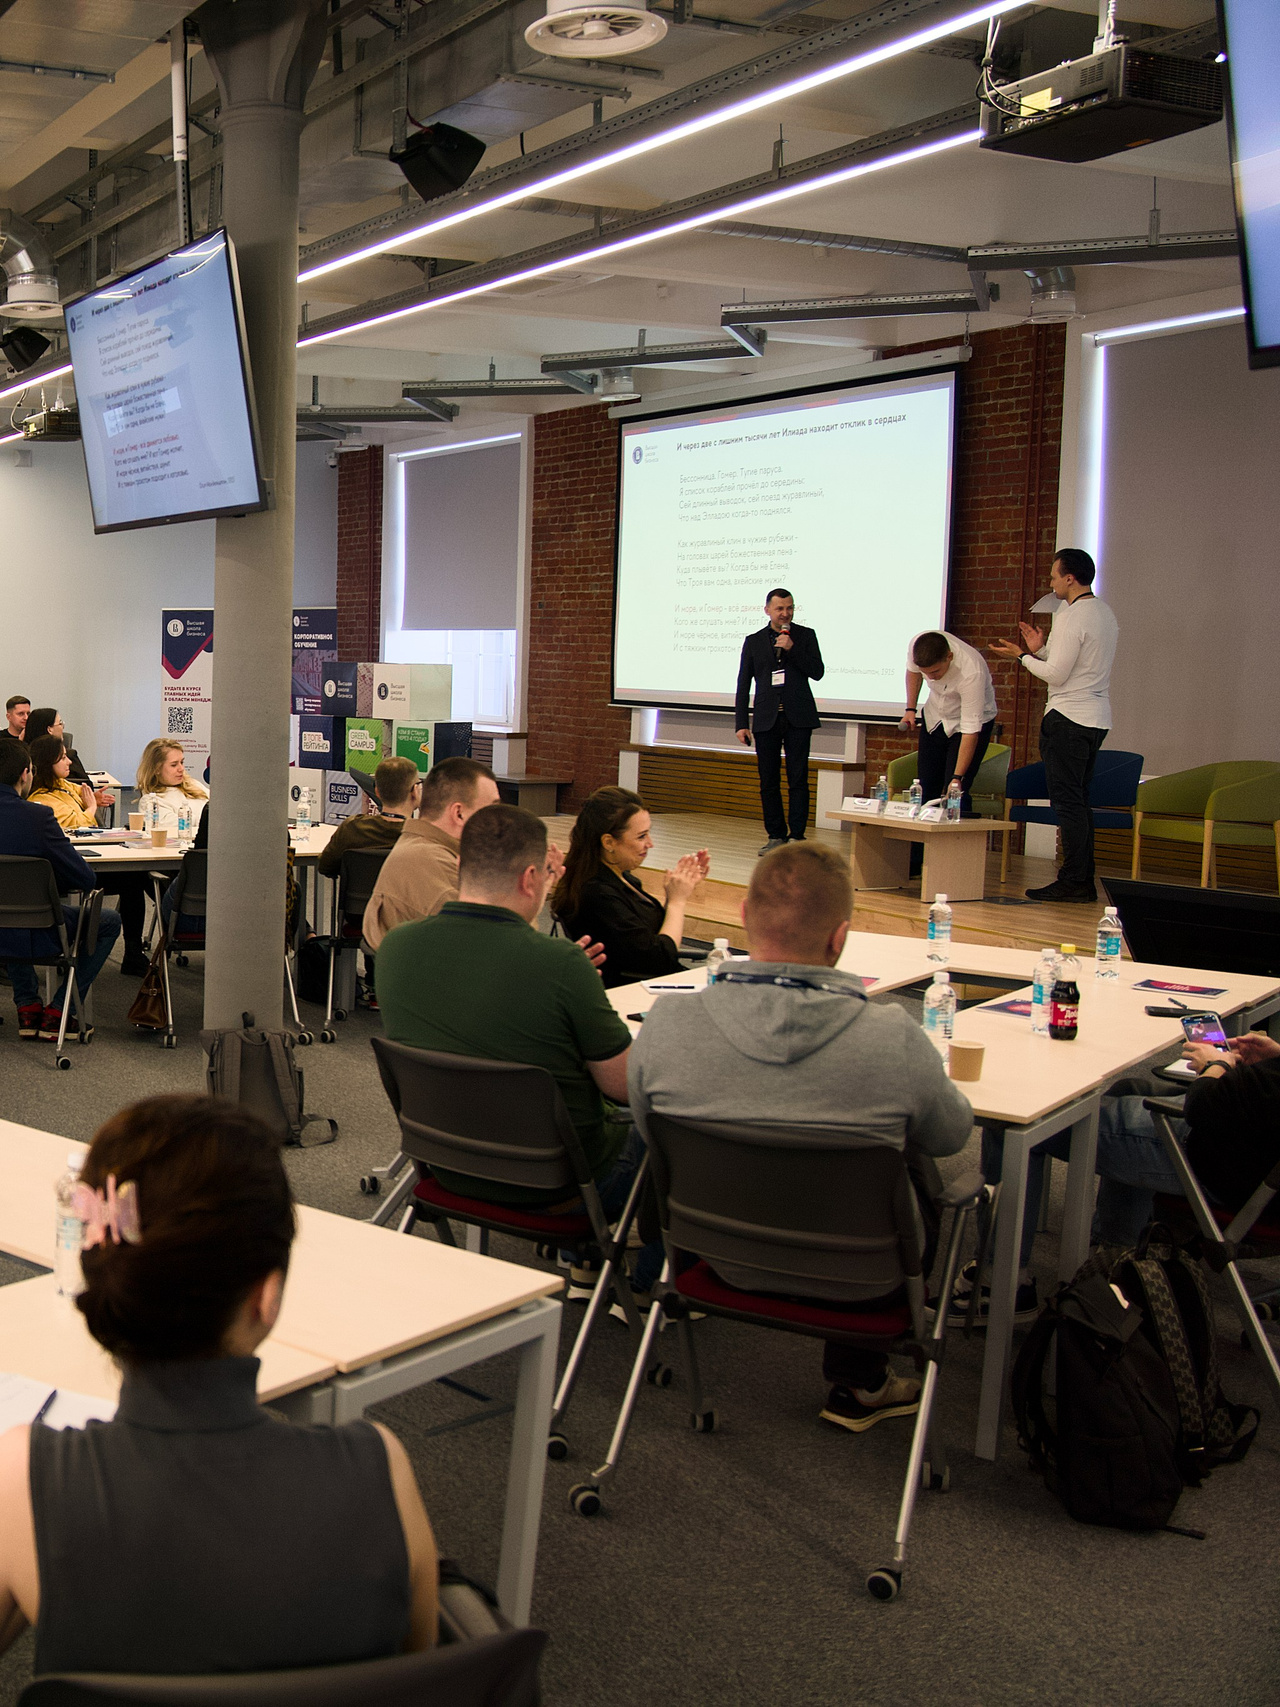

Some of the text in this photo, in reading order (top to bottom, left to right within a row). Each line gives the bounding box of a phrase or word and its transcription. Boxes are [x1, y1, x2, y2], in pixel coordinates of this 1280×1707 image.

[676, 443, 682, 451] И
[683, 443, 700, 452] через
[701, 441, 712, 449] две
[718, 438, 743, 446] лишним
[745, 434, 767, 442] тысячи
[782, 428, 808, 437] Илиада
[809, 424, 838, 433] находит
[840, 420, 866, 430] отклик
[874, 414, 907, 426] сердцах
[740, 468, 757, 478] Тугие
[685, 487, 706, 497] список
[707, 482, 735, 495] кораблей
[679, 500, 691, 509] Сей
[692, 498, 718, 508] длинный
[747, 494, 759, 503] сей
[761, 493, 780, 502] поезд
[679, 513, 689, 522] Что
[702, 510, 730, 520] Элладою
[678, 540, 688, 548] Как
[689, 537, 726, 549] журавлиный
[748, 536, 766, 546] чужие
[768, 532, 793, 545] рубежи
[710, 550, 728, 561] царей
[730, 549, 775, 559] божественная
[677, 566, 690, 575] Куда
[730, 563, 749, 572] Когда
[750, 562, 758, 571] бы
[676, 579, 687, 587] Что
[688, 578, 703, 588] Троя
[734, 577, 762, 585] ахейские
[674, 604, 680, 612] И
[704, 603, 723, 613] Гомер
[699, 618, 722, 627] слушать
[350, 732, 368, 740] GREEN
[303, 741, 329, 750] РЕЙТИНГА
[350, 740, 374, 749] CAMPUS
[331, 784, 357, 794] BUSINESS
